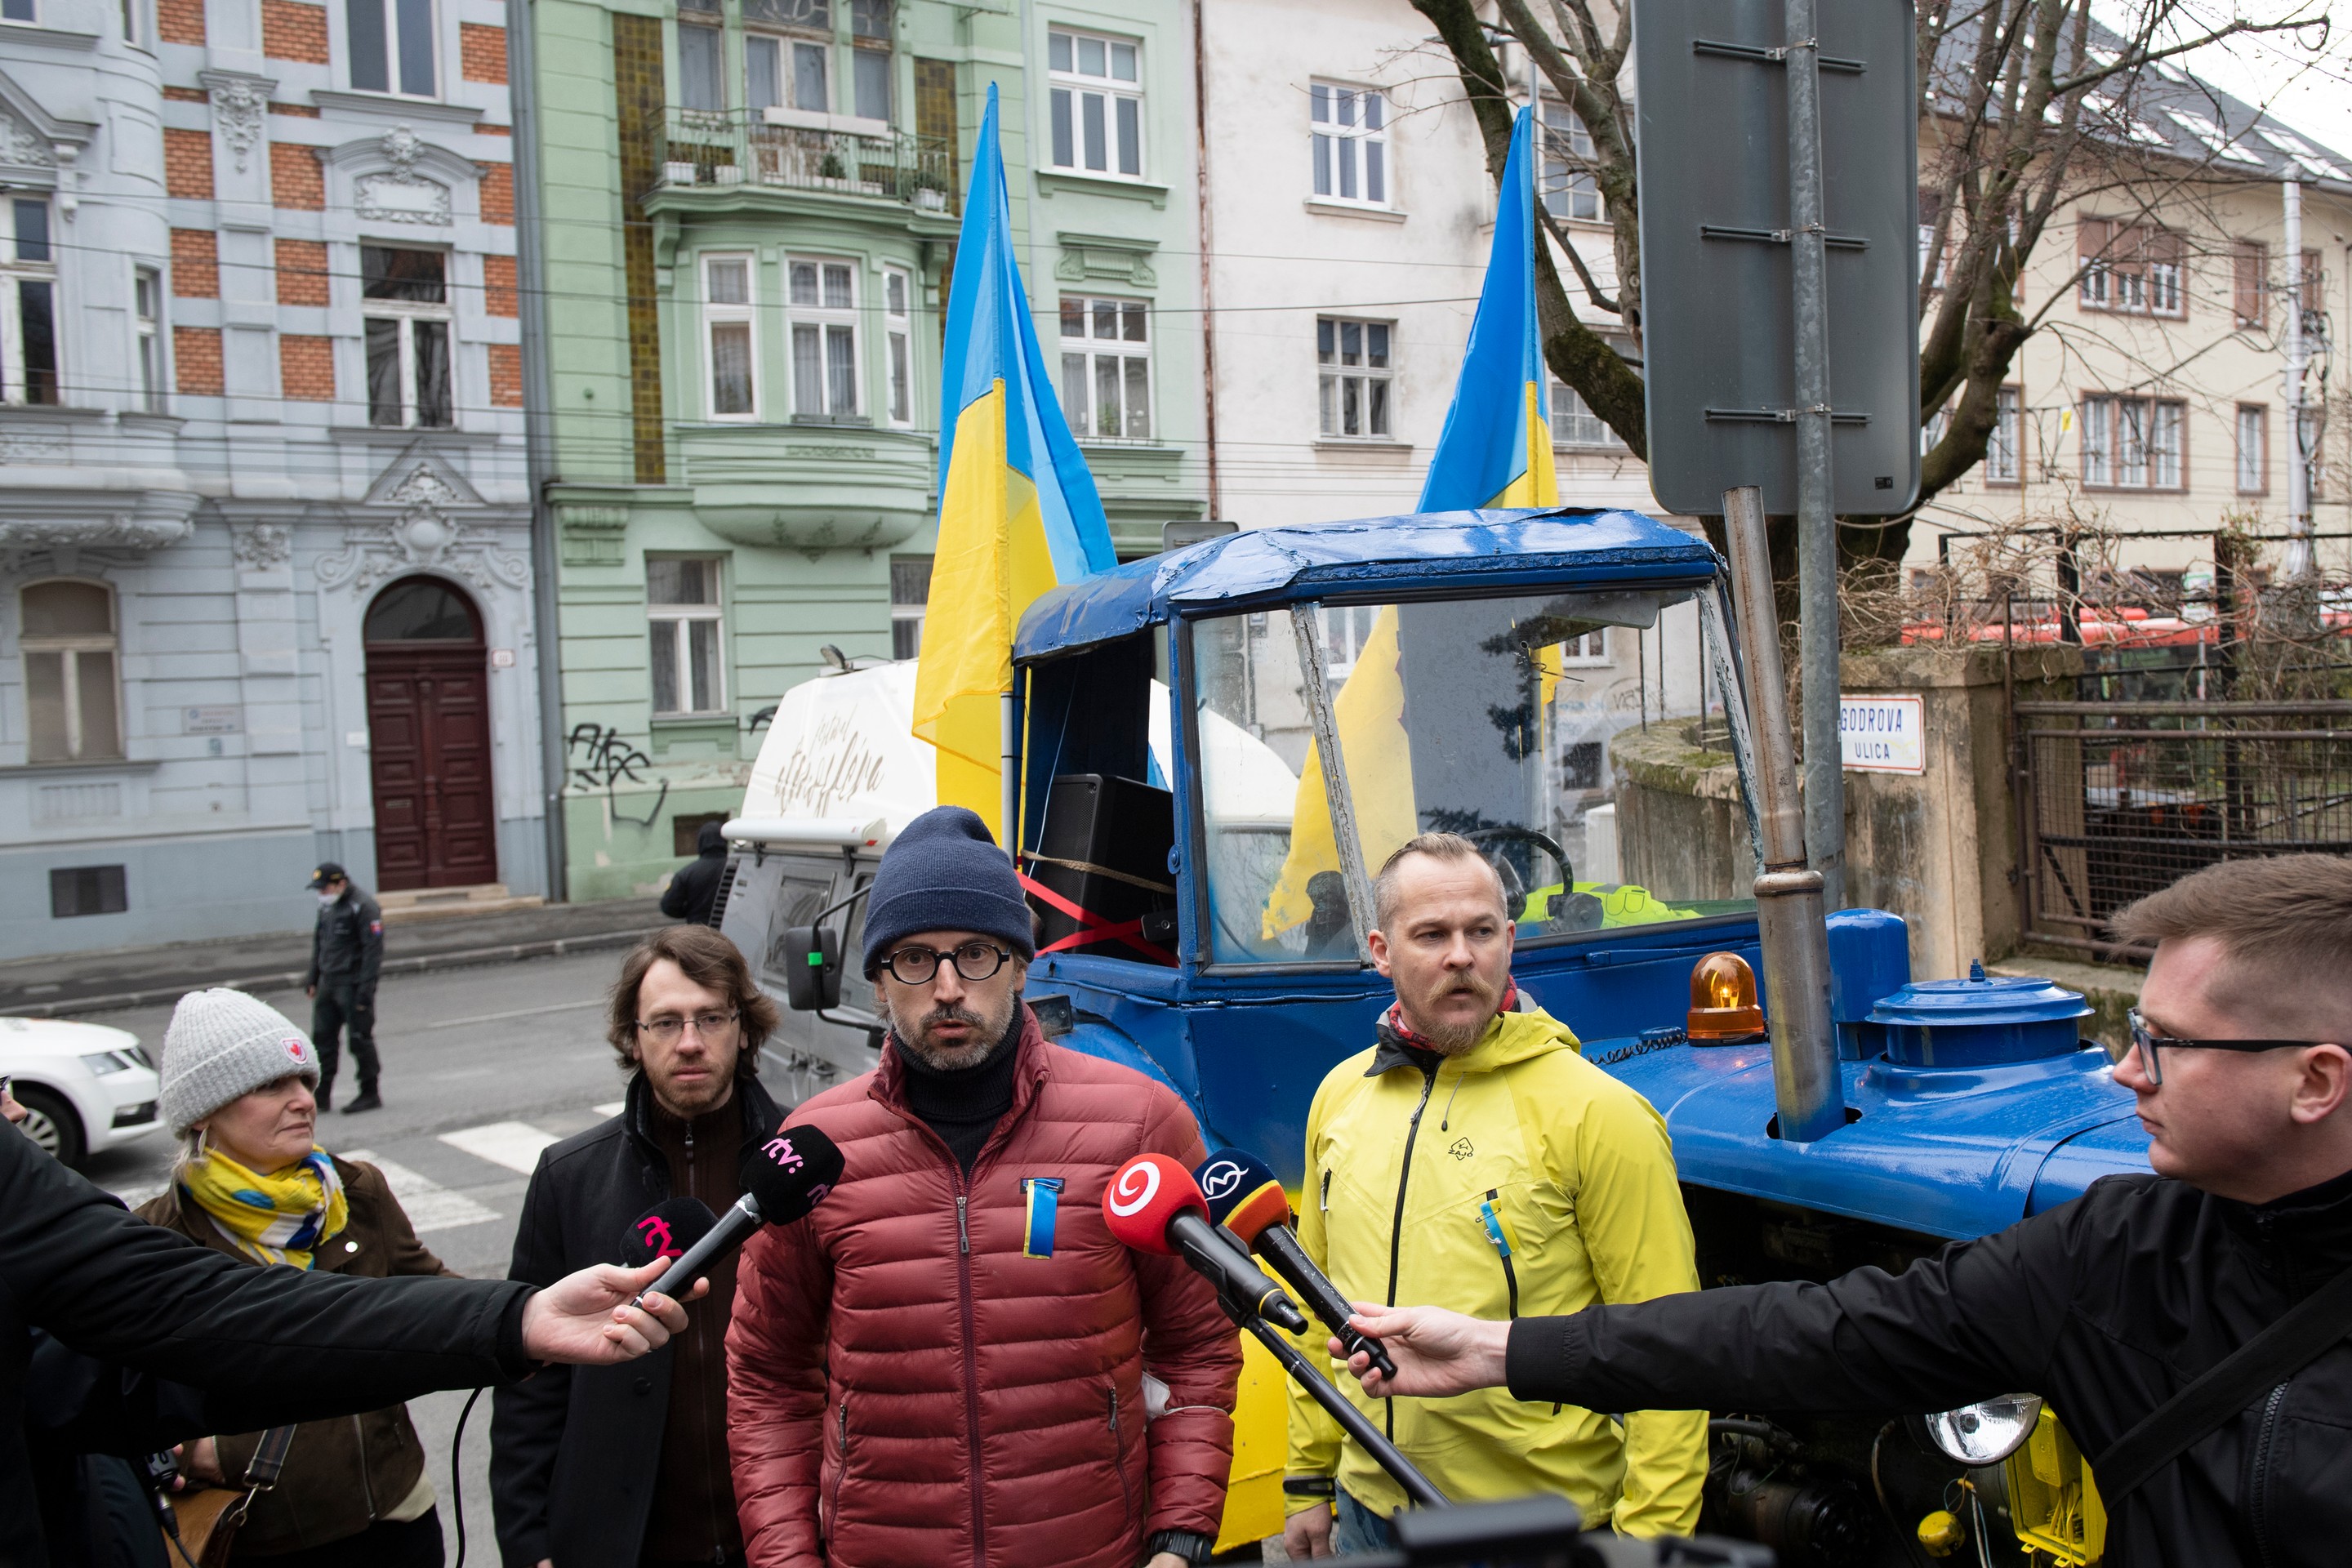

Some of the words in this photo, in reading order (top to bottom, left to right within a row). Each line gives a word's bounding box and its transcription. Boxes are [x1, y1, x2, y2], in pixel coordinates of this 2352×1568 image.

[1841, 707, 1902, 732] GODROVA
[1855, 742, 1891, 760] ULICA
[1280, 1306, 1299, 1321] SONY
